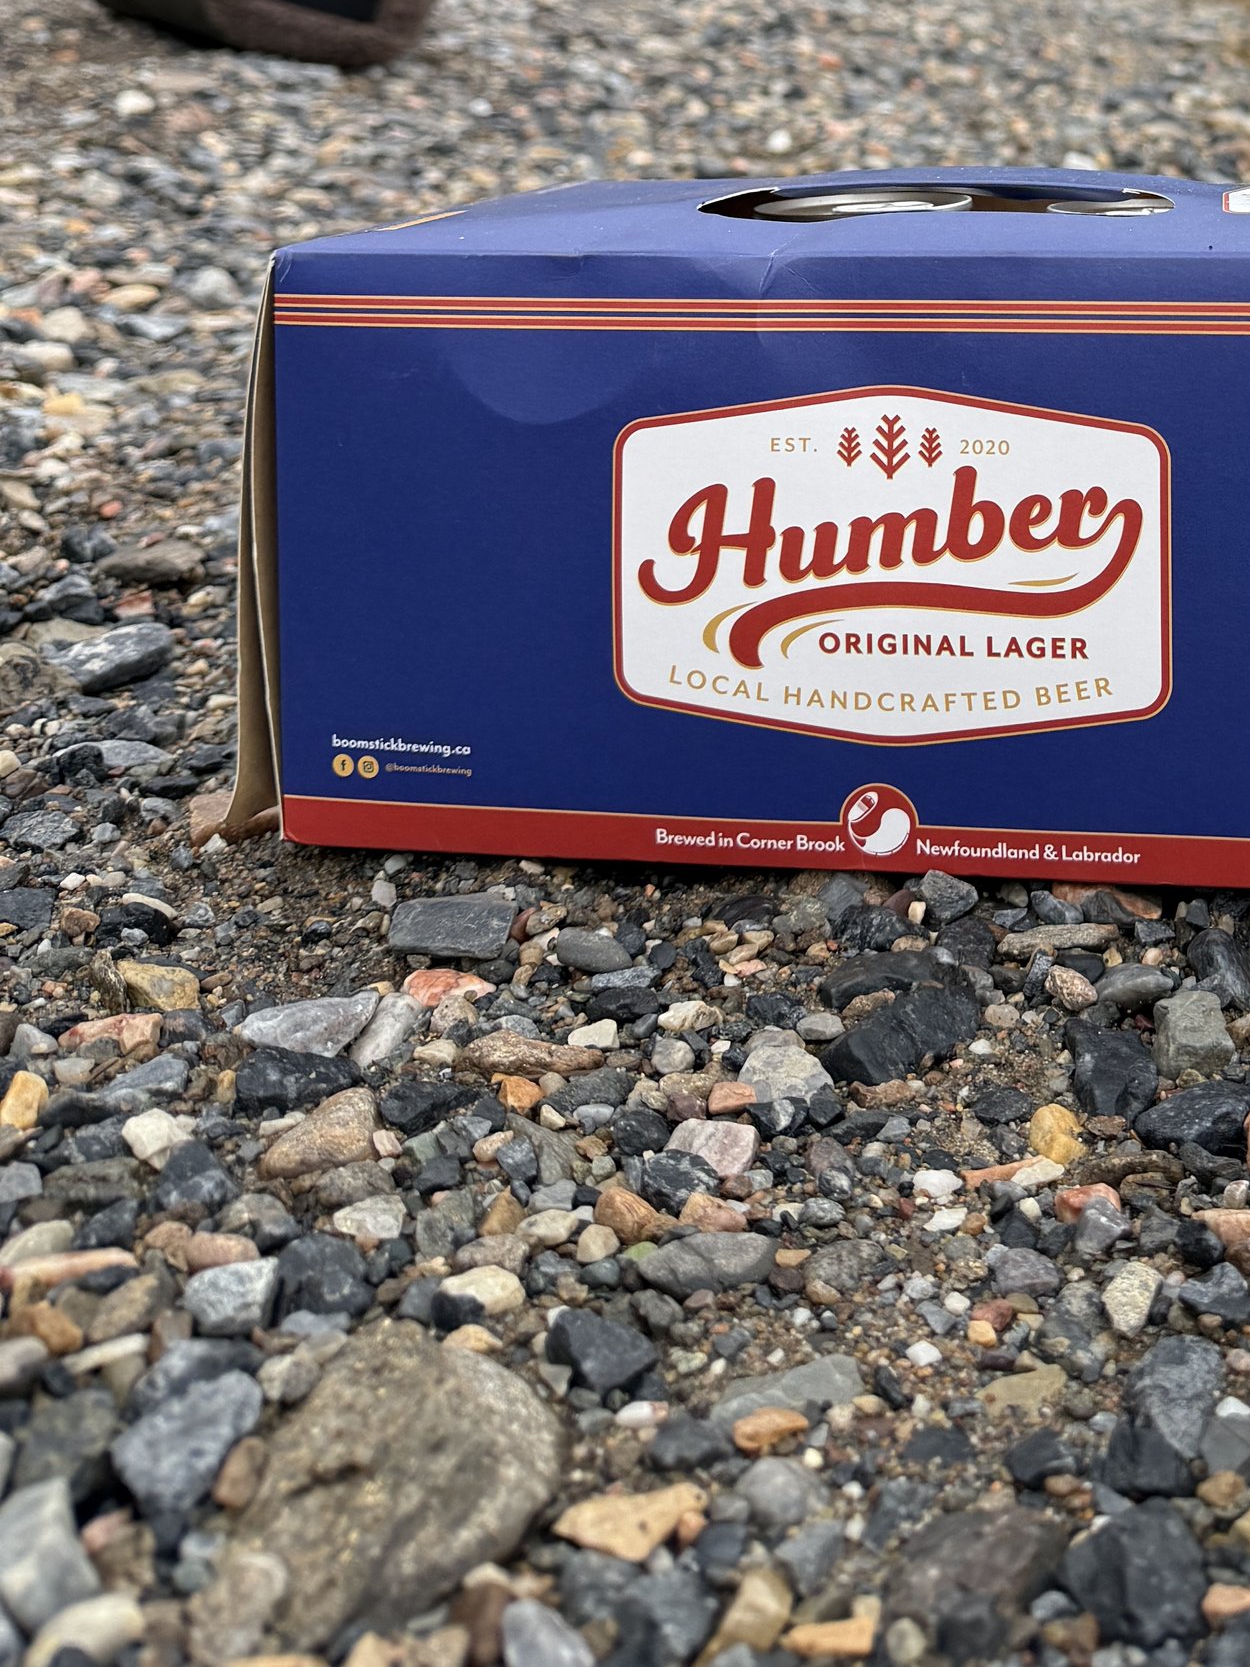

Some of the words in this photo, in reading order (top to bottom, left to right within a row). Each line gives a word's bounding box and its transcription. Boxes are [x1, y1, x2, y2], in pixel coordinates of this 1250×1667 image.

[770, 437, 819, 453] EST.
[960, 439, 1011, 456] 2020
[638, 465, 1143, 608] Humber
[819, 632, 974, 658] ORIGINAL
[986, 636, 1090, 660] LAGER
[669, 664, 769, 702] LOCAL
[783, 687, 1021, 713] HANDCRAFTED
[1036, 676, 1113, 707] BEER
[331, 734, 471, 757] boomstickbrewing.ca
[385, 762, 472, 777] @boomstickbrewing
[656, 828, 715, 847] Brewed
[718, 832, 734, 848] in
[736, 833, 794, 850] Corner
[796, 834, 845, 852] Brook
[916, 838, 1040, 860] Newfoundland
[1043, 844, 1059, 861] &
[1062, 845, 1140, 864] Labrador
